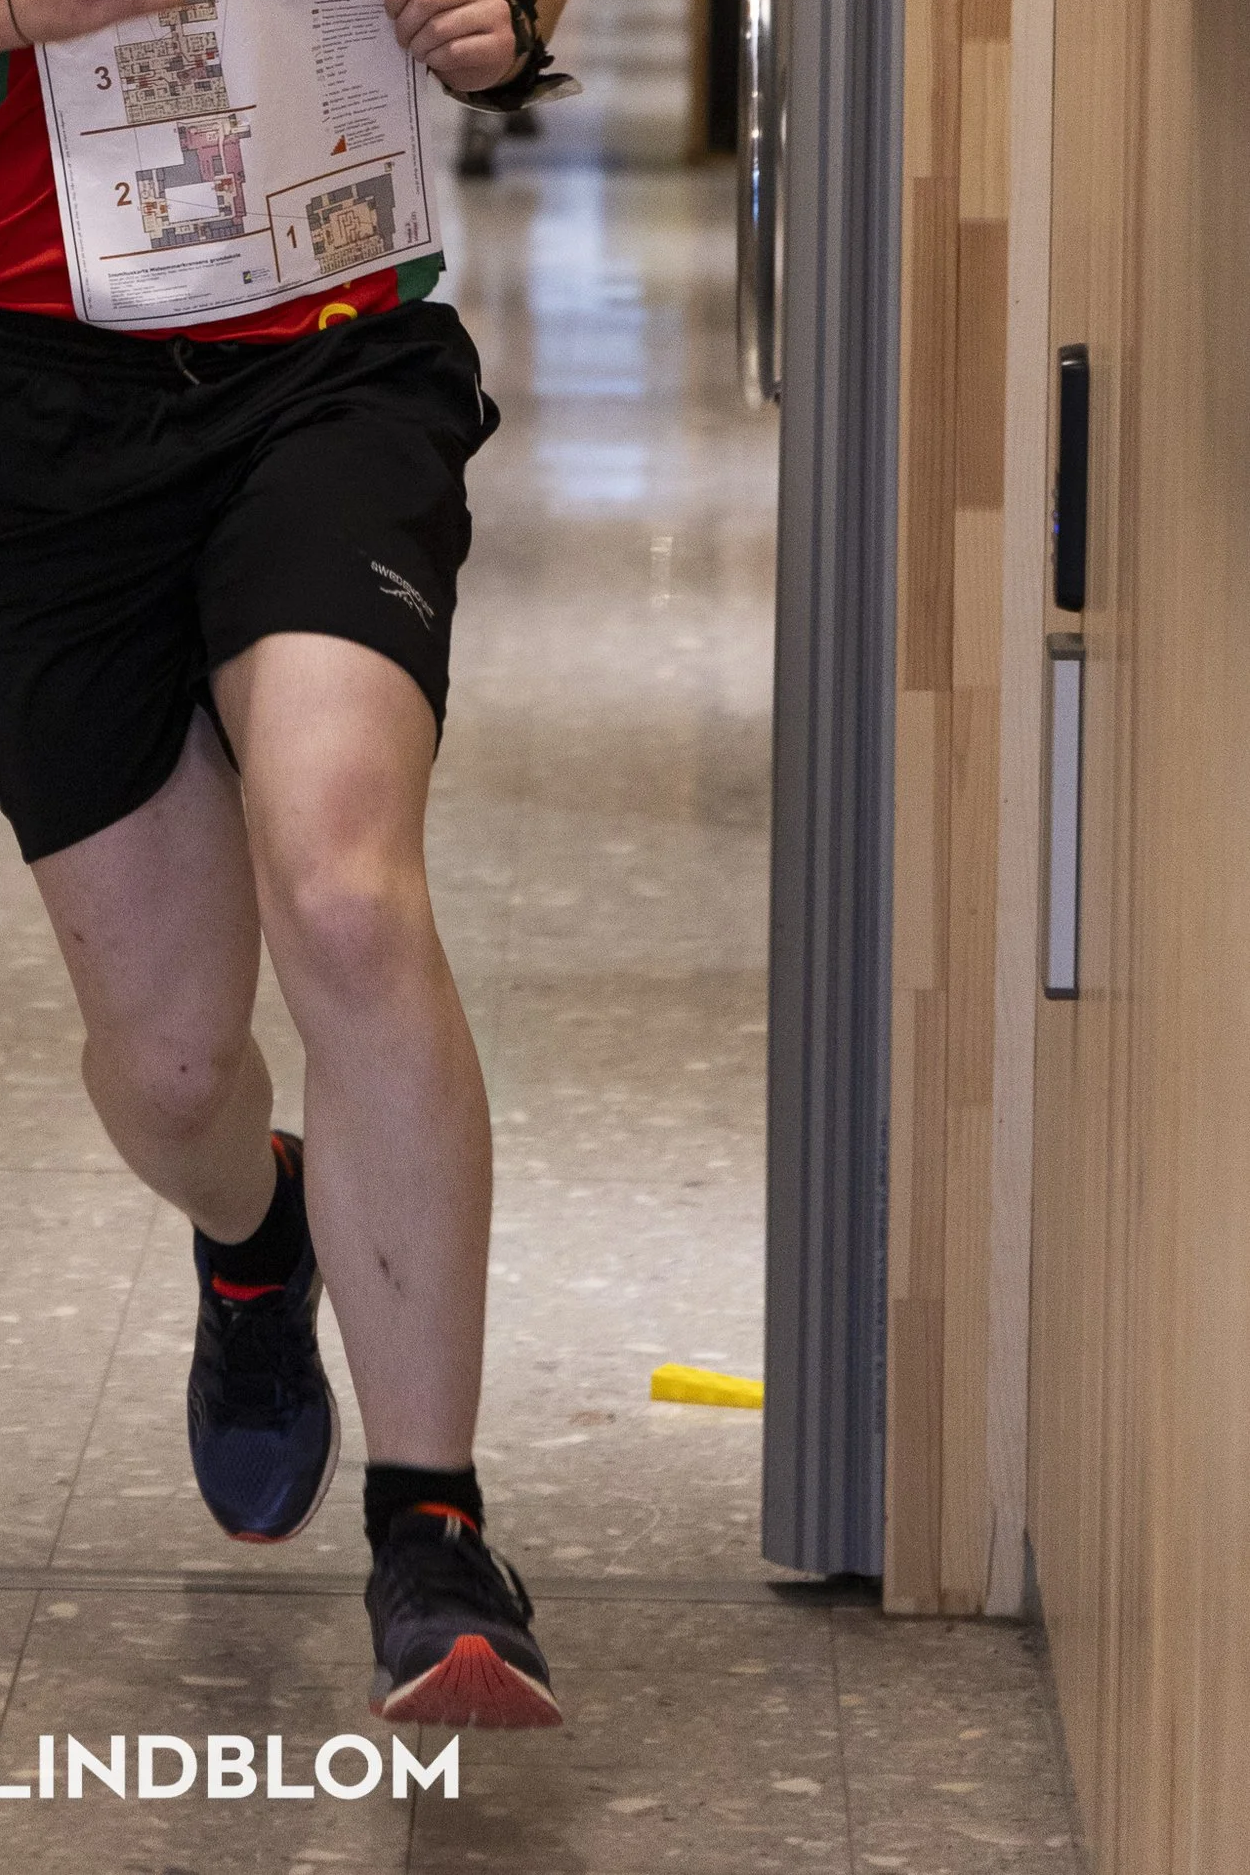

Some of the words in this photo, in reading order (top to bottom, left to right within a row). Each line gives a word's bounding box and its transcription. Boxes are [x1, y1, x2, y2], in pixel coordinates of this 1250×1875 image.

[94, 66, 113, 91] 3
[114, 181, 132, 207] 2
[286, 225, 299, 249] 1
